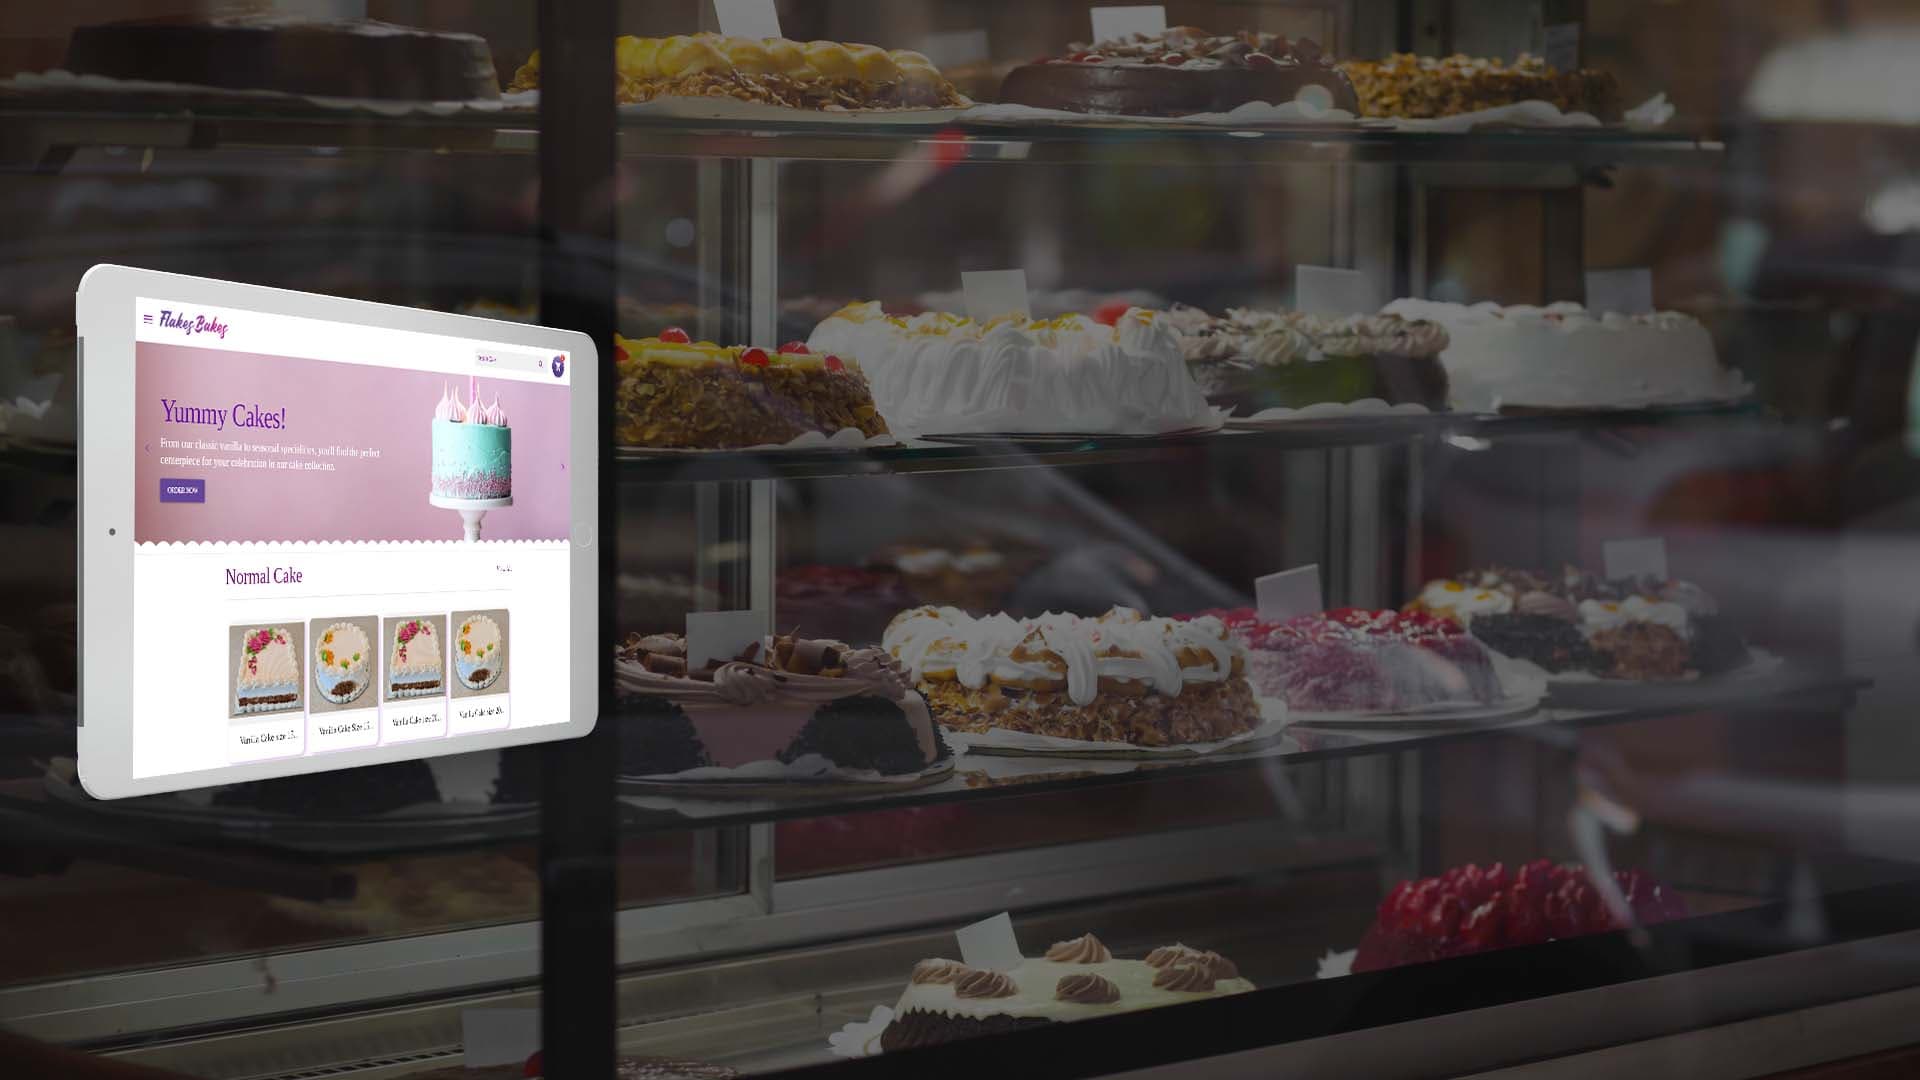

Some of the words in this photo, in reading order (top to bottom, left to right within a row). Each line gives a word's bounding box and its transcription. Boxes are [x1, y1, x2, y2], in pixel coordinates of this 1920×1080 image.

[160, 310, 194, 335] Flakes
[194, 315, 228, 339] Bakes
[161, 399, 227, 431] Yummy
[232, 404, 285, 430] Cakes!
[160, 437, 180, 449] From
[181, 440, 194, 449] our
[360, 447, 381, 459] perfect
[160, 456, 200, 468] centerpiece
[201, 456, 212, 466] for
[225, 567, 271, 585] Normal
[273, 566, 303, 584] Cake
